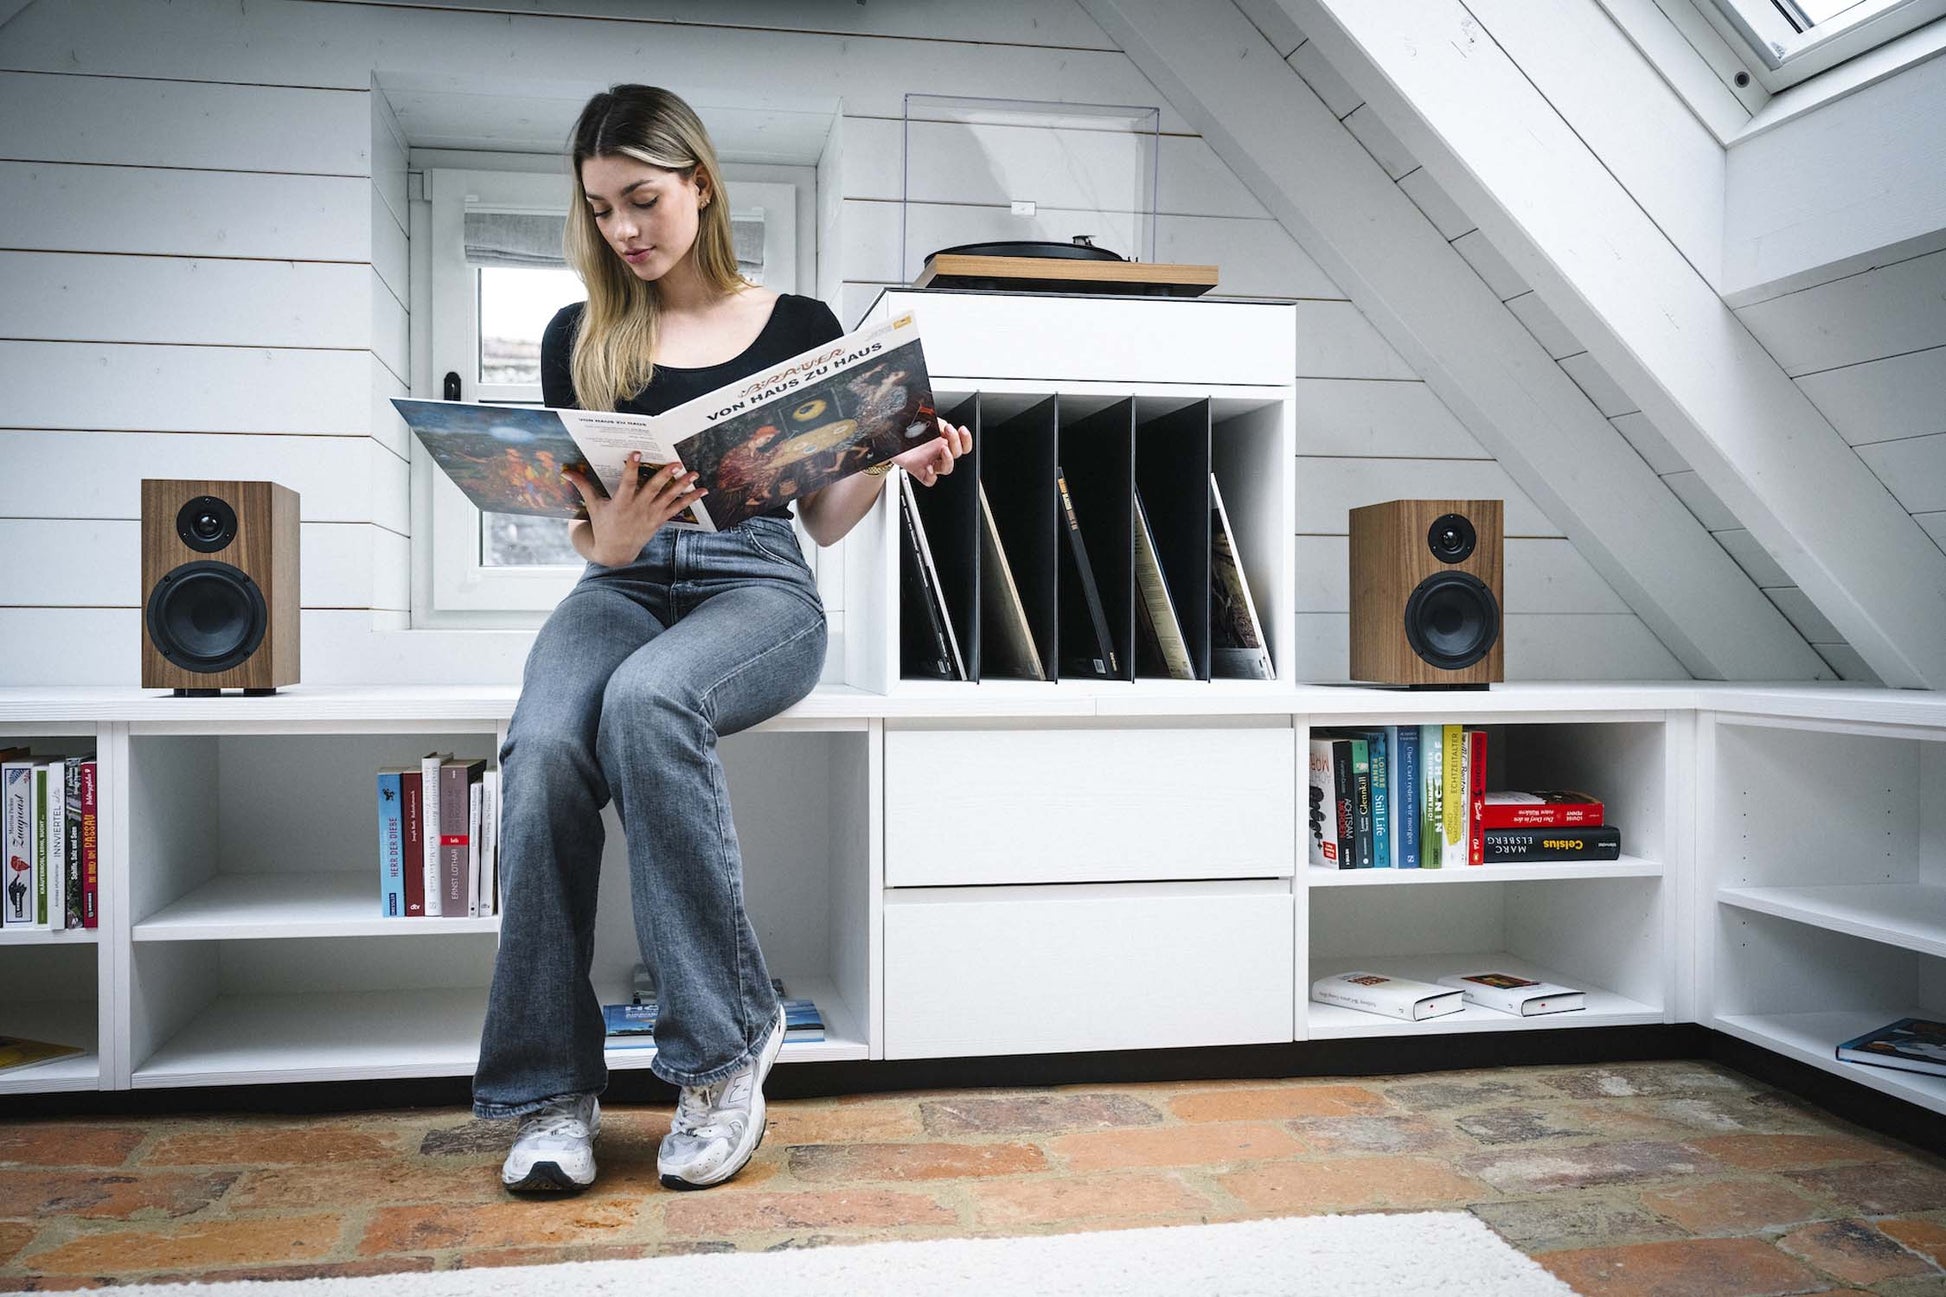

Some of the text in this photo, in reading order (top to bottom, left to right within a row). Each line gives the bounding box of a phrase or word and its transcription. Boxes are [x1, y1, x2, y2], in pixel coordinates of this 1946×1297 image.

[707, 343, 882, 421] VON HAUS ZU HAUS
[1450, 733, 1458, 794] ECHTZEITALTER
[1360, 776, 1368, 815] Glennkill
[53, 806, 61, 857] INNVIERTEL
[84, 814, 96, 848] PASSAU
[1345, 799, 1353, 839] ACHTSAM
[1375, 795, 1386, 836] Still Life
[389, 818, 398, 877] HERR DER DIEBE
[1487, 836, 1533, 844] ELSBERG
[1495, 845, 1526, 853] MARC
[1543, 840, 1583, 850] Celsius
[451, 878, 459, 900] ERNST
